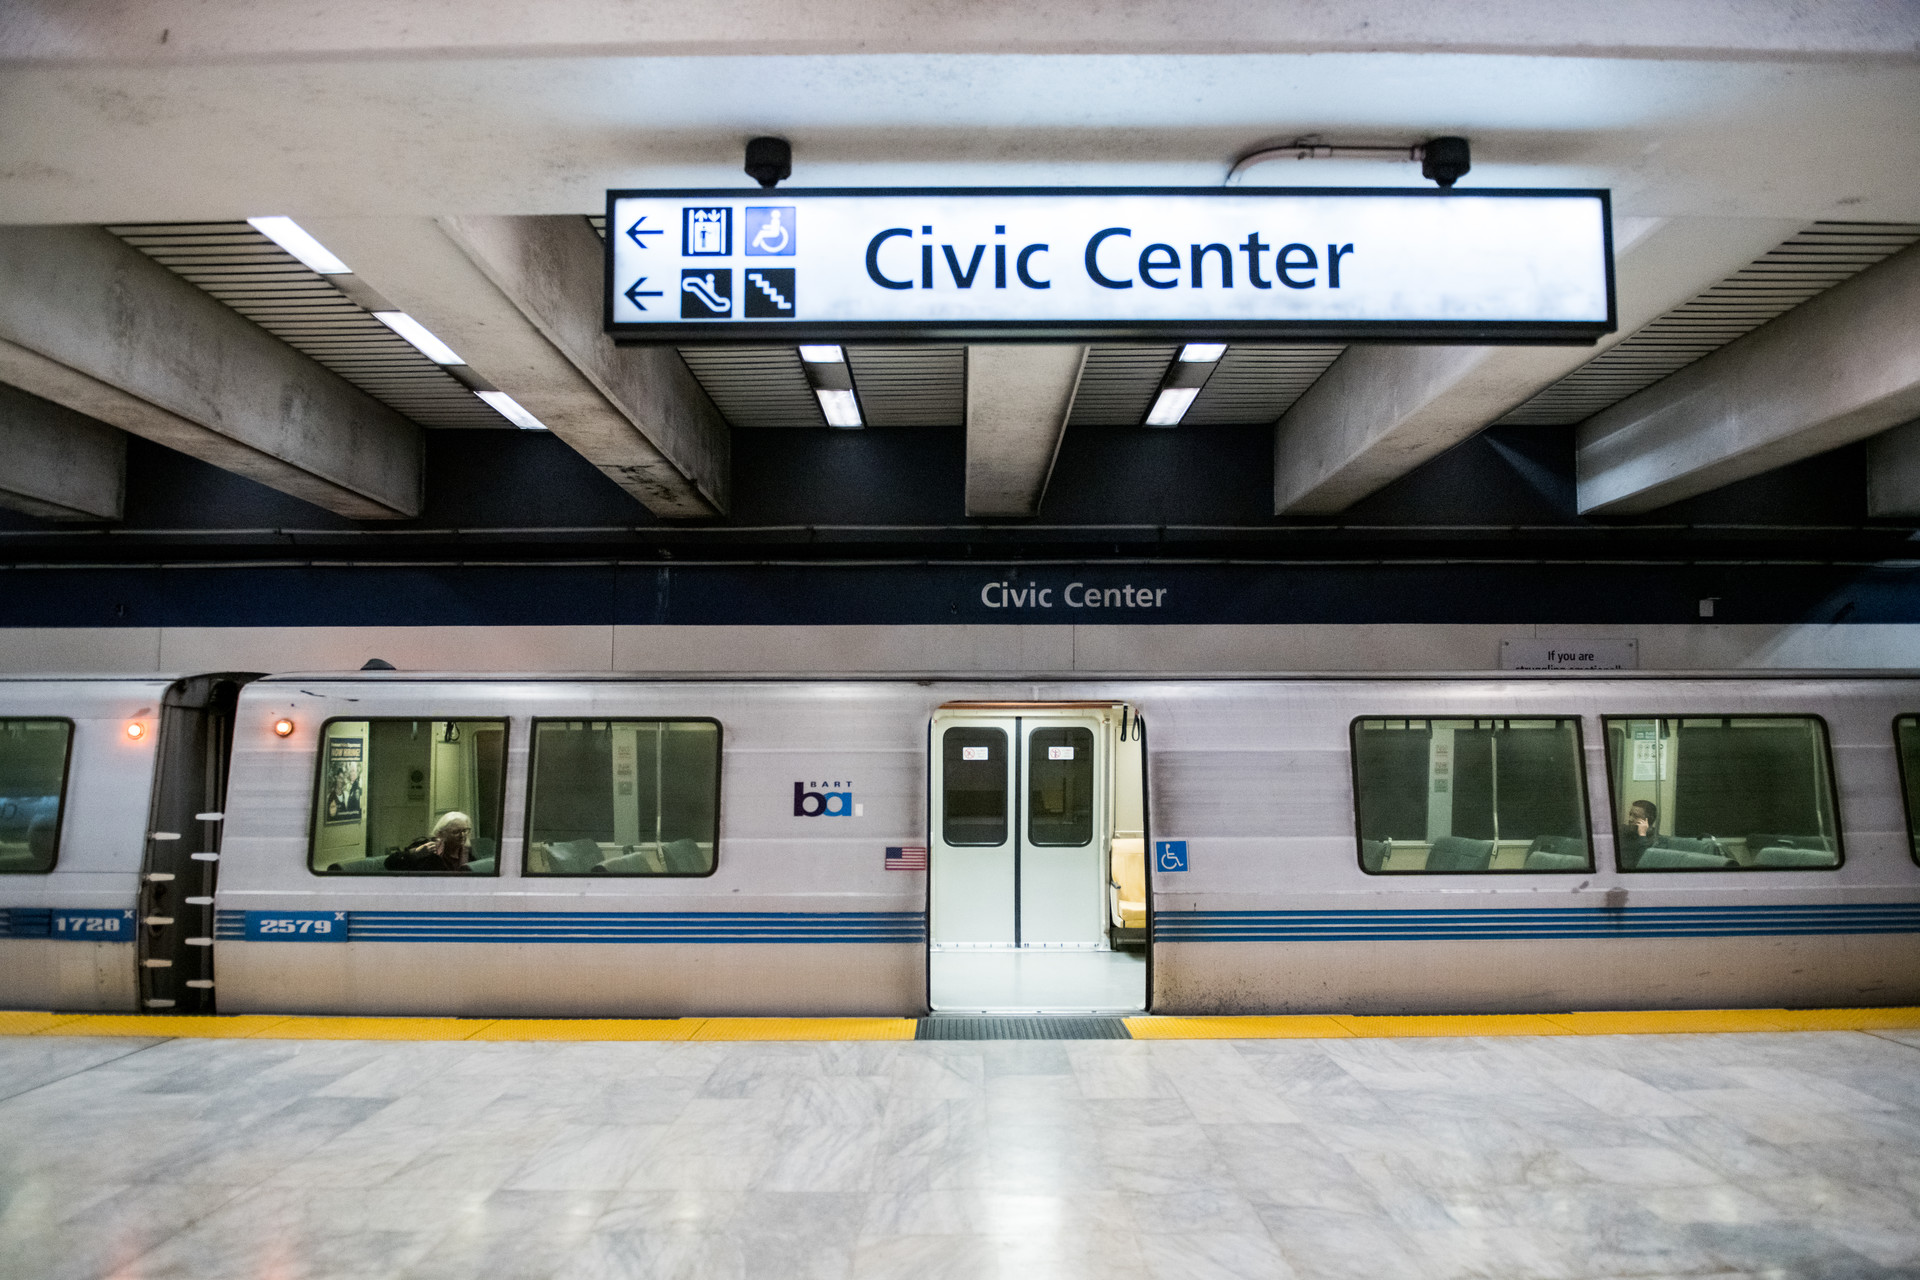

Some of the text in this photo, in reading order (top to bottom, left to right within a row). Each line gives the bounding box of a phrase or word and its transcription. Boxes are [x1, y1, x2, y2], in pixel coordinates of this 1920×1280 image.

[865, 225, 1354, 290] Civic Center
[980, 581, 1168, 609] Civic Center
[1547, 650, 1595, 664] If you are
[809, 780, 853, 788] BART
[56, 917, 120, 932] 1728
[260, 919, 332, 934] 2579
